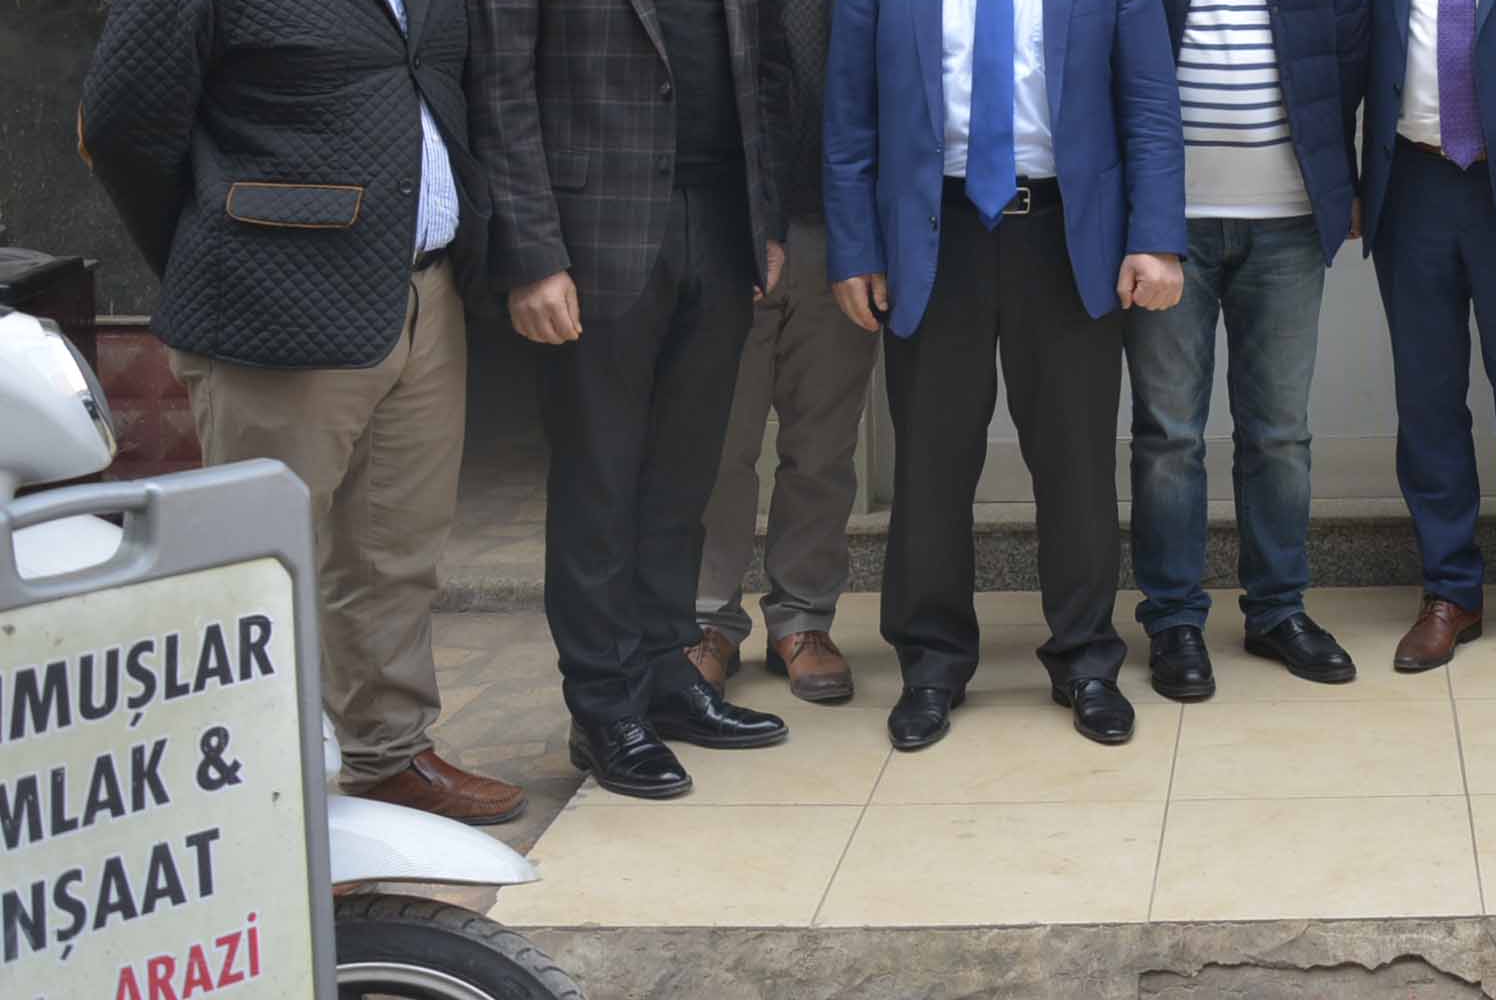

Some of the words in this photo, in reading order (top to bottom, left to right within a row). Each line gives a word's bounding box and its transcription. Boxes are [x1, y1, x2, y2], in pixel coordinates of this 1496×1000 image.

[0, 614, 275, 744] MUŞLAR
[0, 737, 171, 851] MLAK
[195, 725, 243, 792] &
[1, 827, 220, 964] NŞAAT
[115, 911, 261, 1000] ARAZİ
